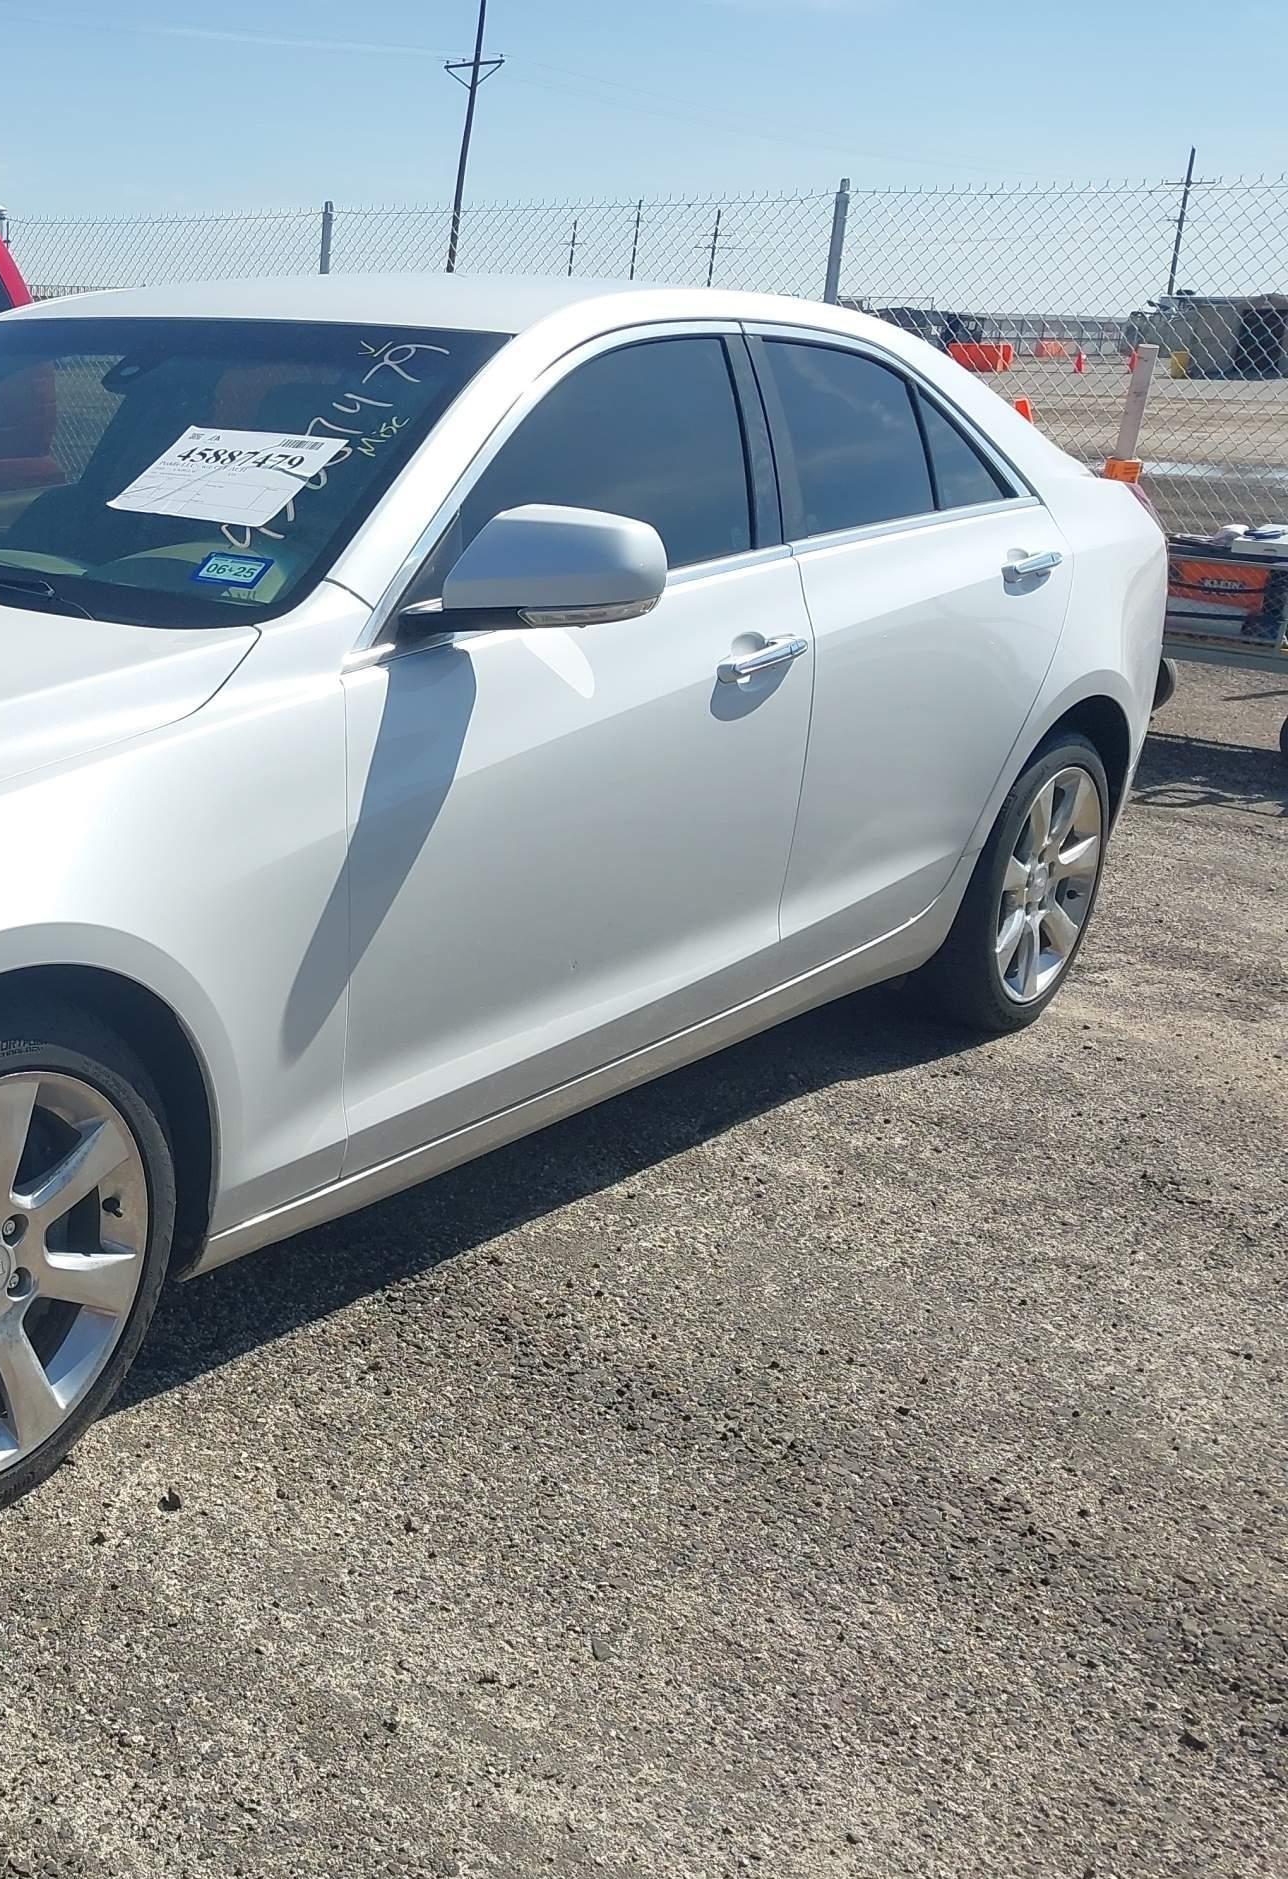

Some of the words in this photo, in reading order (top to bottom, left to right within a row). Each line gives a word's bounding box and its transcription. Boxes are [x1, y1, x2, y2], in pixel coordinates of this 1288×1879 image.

[177, 446, 305, 470] 45887479
[206, 563, 229, 575] 06
[233, 566, 258, 578] 25
